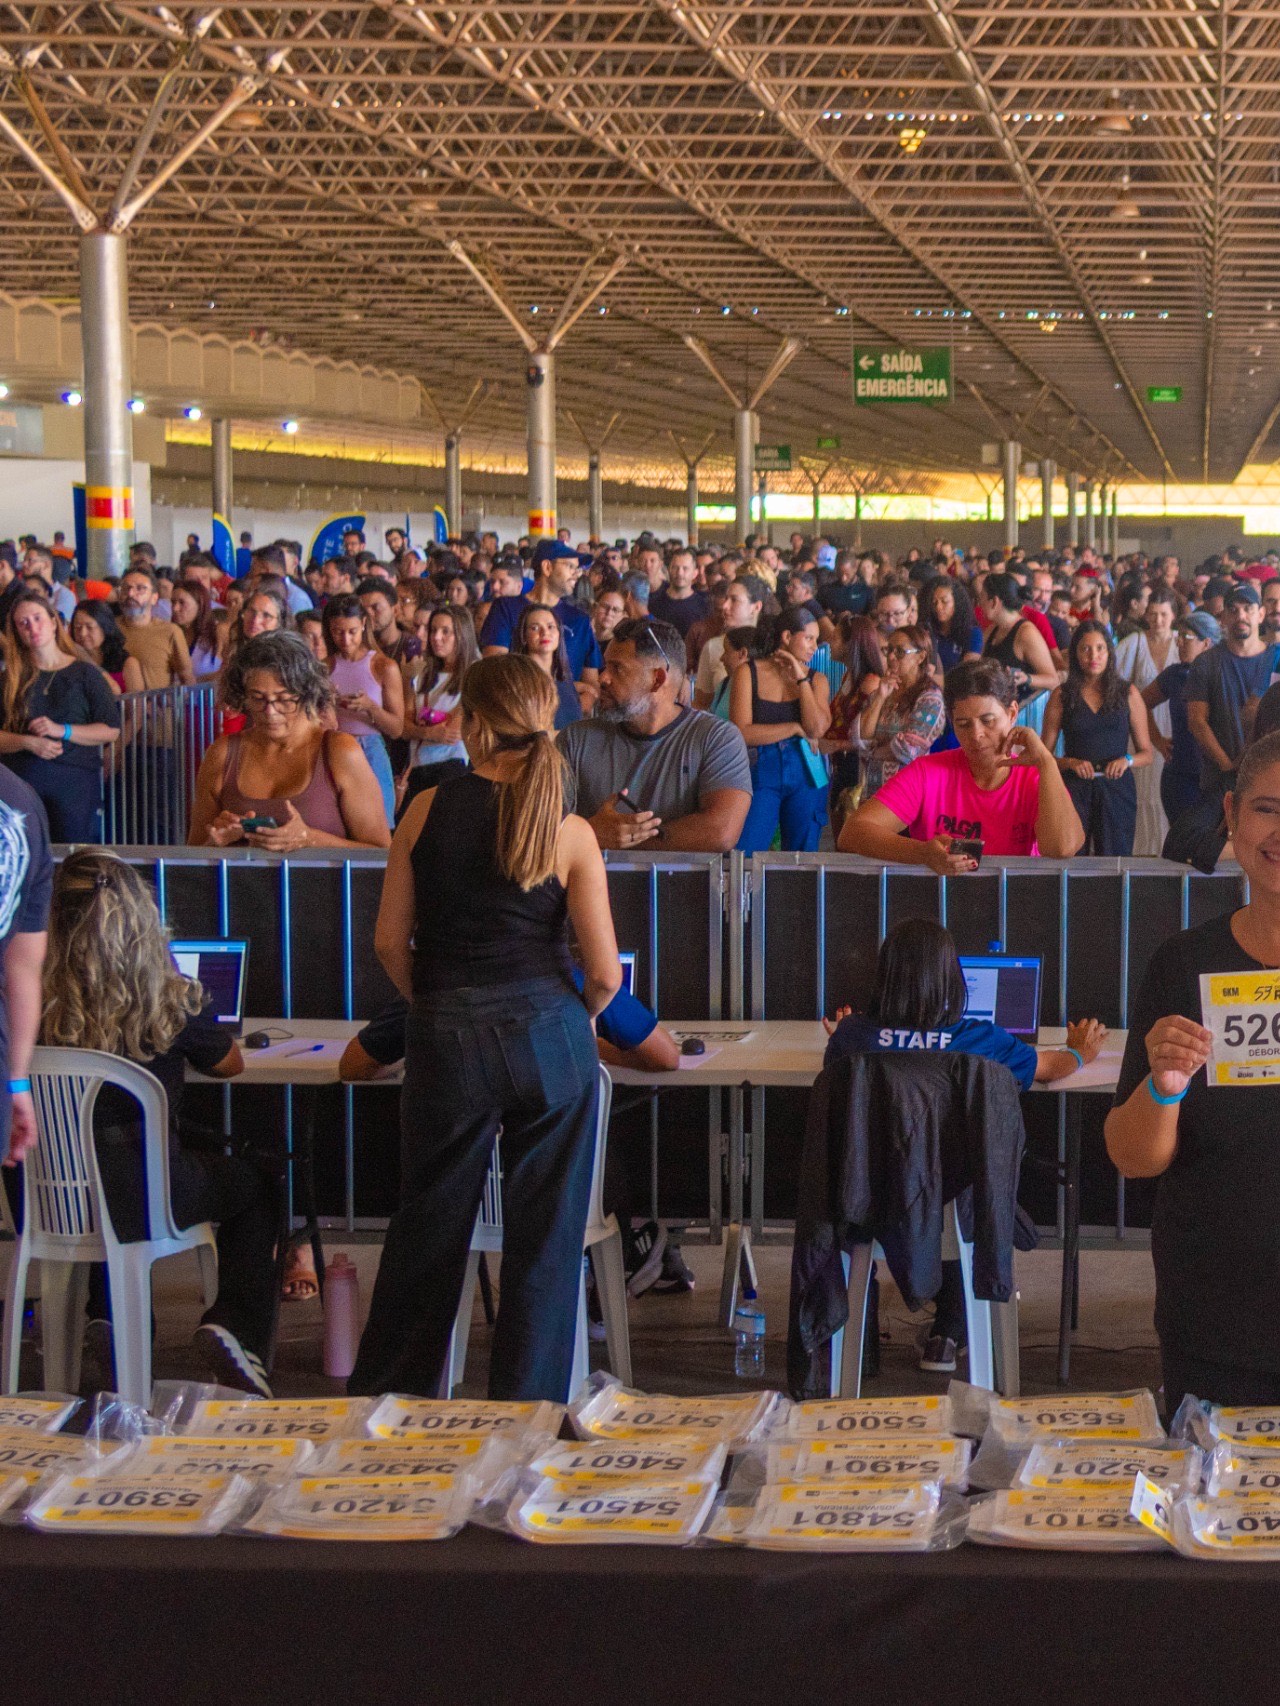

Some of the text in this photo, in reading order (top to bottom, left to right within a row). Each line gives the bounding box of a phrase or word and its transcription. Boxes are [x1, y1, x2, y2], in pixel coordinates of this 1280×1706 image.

[881, 350, 923, 373] SAÍDA
[856, 374, 948, 398] EMERGÊNCIA
[878, 1028, 952, 1050] STAFF
[398, 1416, 515, 1430] 54401
[610, 1411, 724, 1428] 54701
[816, 1416, 927, 1432] 55001
[1016, 1411, 1126, 1426] 55301
[567, 1454, 687, 1471] 54601
[823, 1459, 940, 1473] 54901
[1049, 1461, 1170, 1478] 55201
[73, 1491, 203, 1507] 53901
[308, 1498, 437, 1514] 54201
[555, 1500, 682, 1515] 54501
[791, 1511, 916, 1527] 54801
